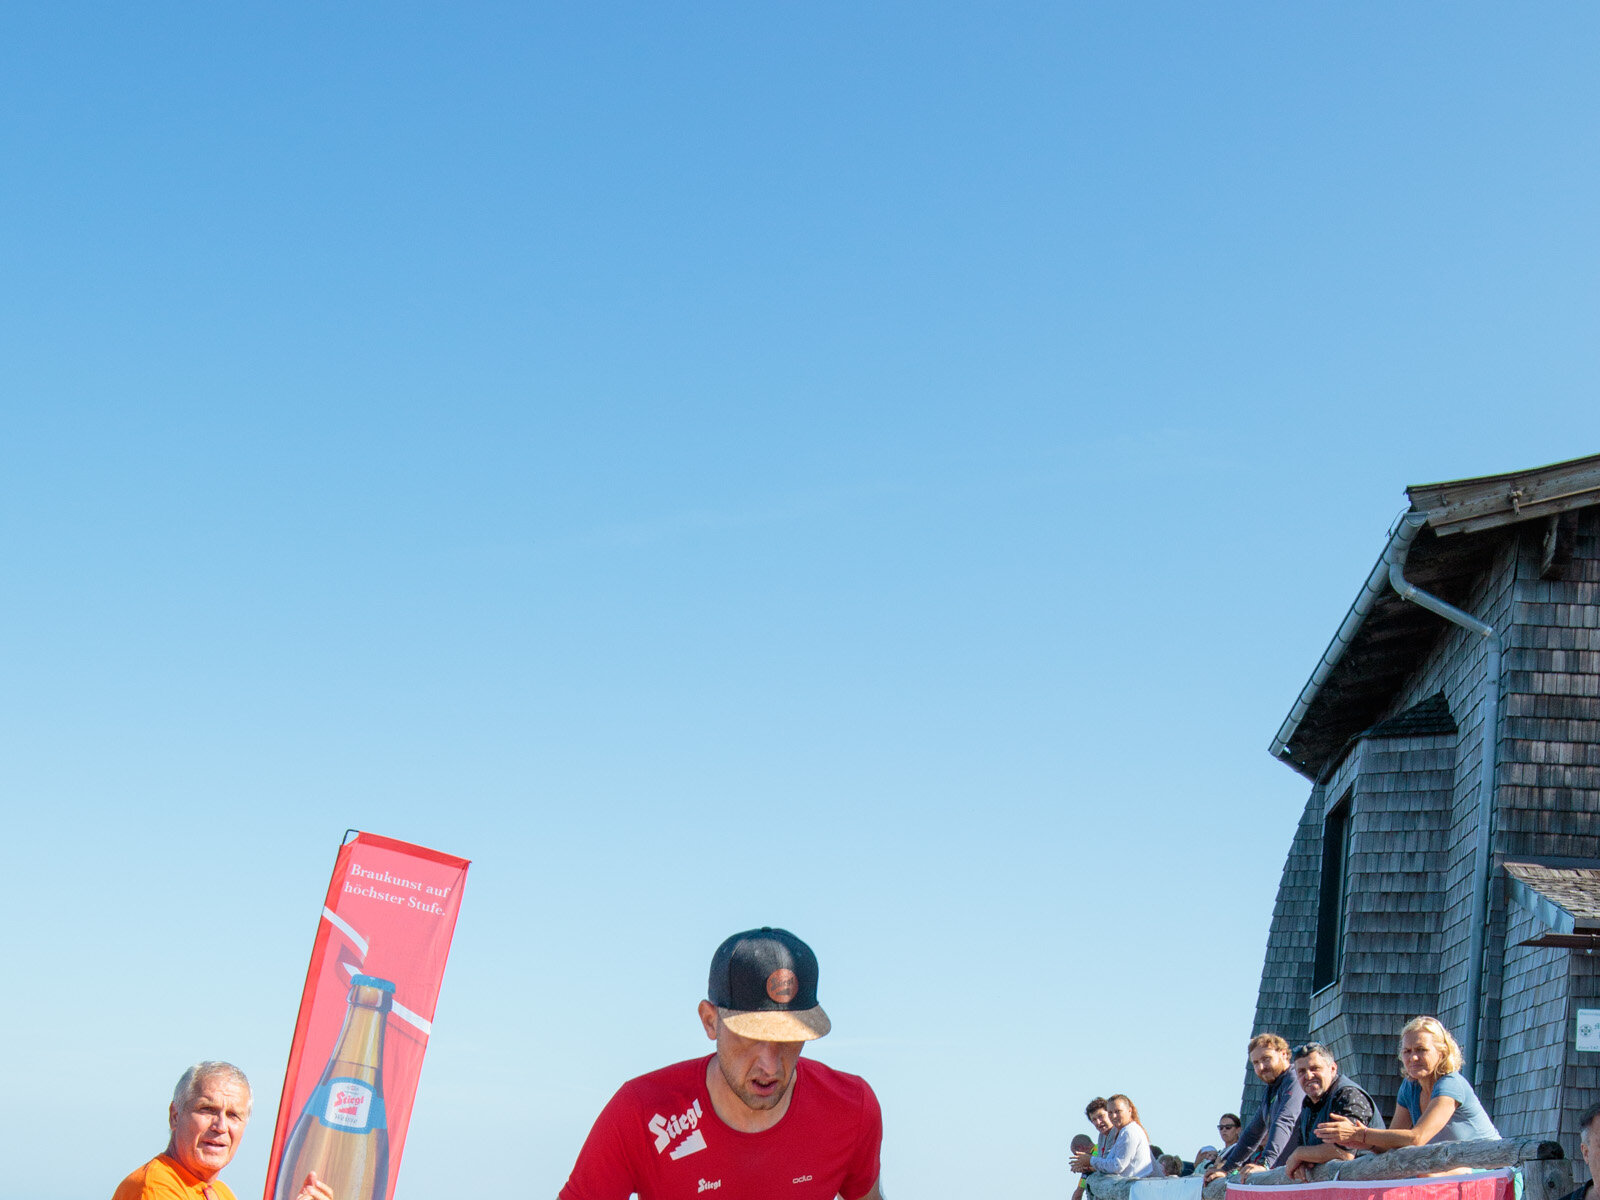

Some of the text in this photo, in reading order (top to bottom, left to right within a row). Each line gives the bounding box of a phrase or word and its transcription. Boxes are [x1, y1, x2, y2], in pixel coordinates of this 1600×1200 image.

[351, 863, 452, 898] Braukunst auf
[343, 881, 446, 916] höchster Stufe.
[648, 1098, 703, 1155] Stiegl
[698, 1178, 721, 1193] Stiegl
[792, 1174, 812, 1184] odlo
